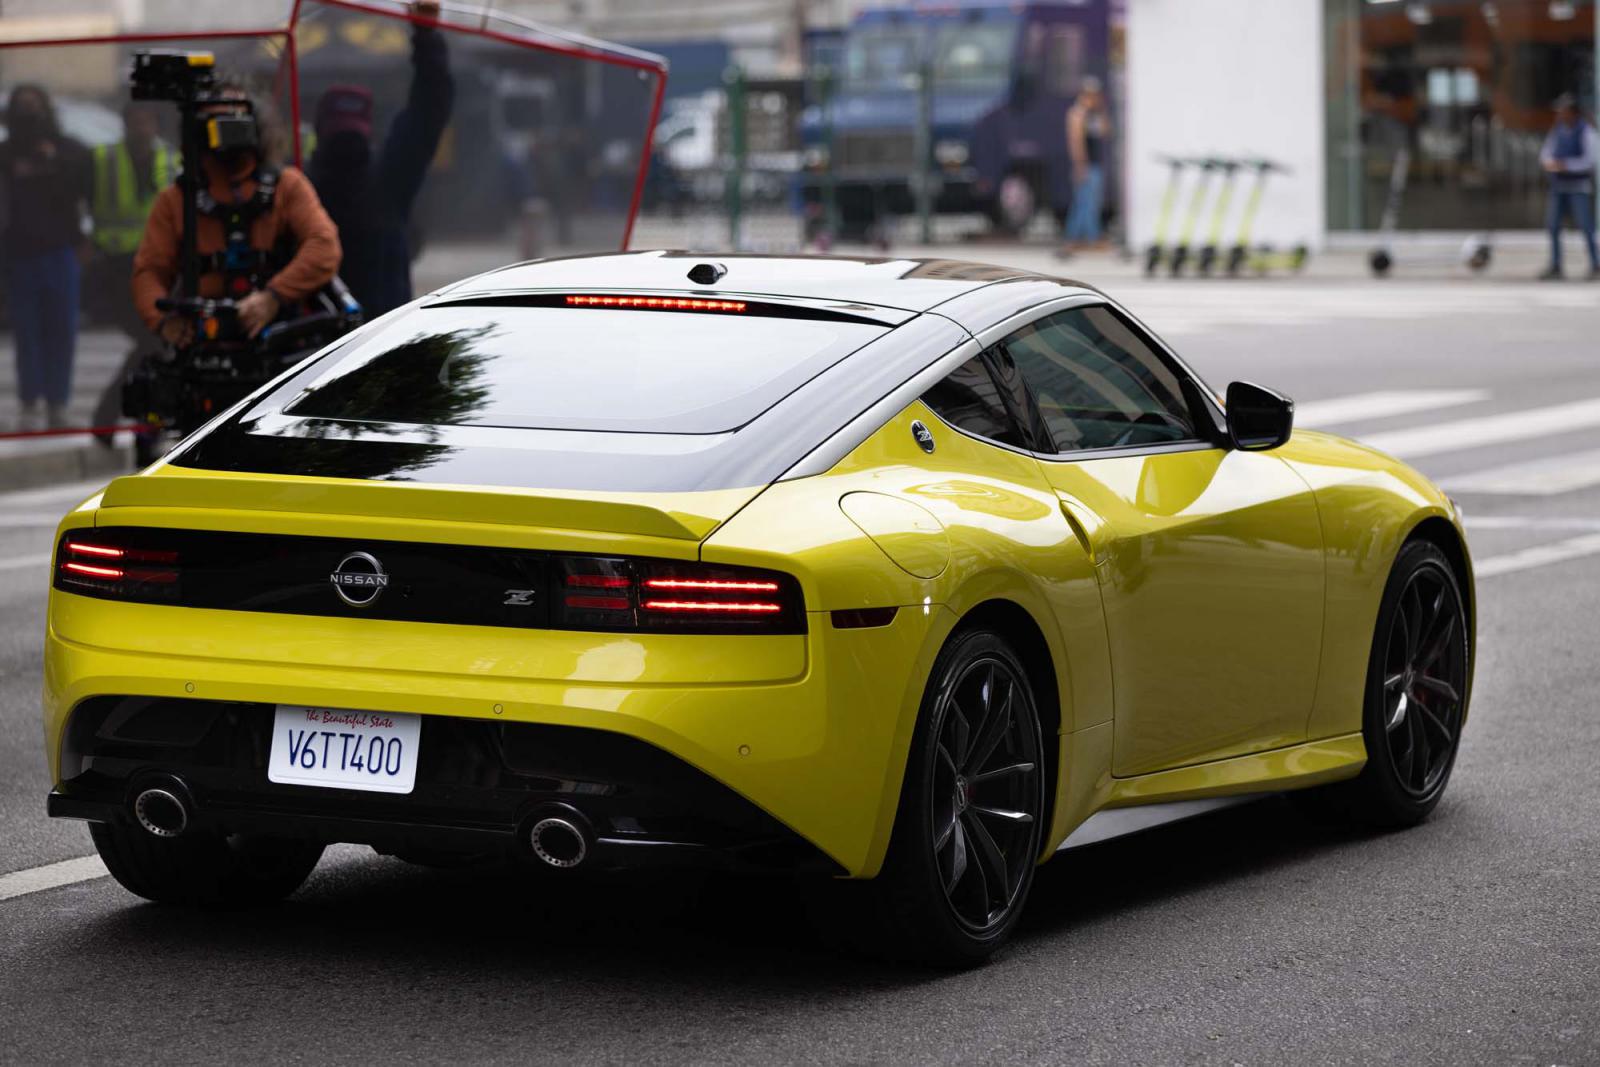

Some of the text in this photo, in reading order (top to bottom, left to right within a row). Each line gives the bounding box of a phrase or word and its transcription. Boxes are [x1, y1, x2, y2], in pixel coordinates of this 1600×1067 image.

[330, 573, 387, 586] NISSAN
[503, 589, 535, 605] Z
[305, 709, 394, 729] The Beautiful State
[288, 729, 403, 776] V6TT400
